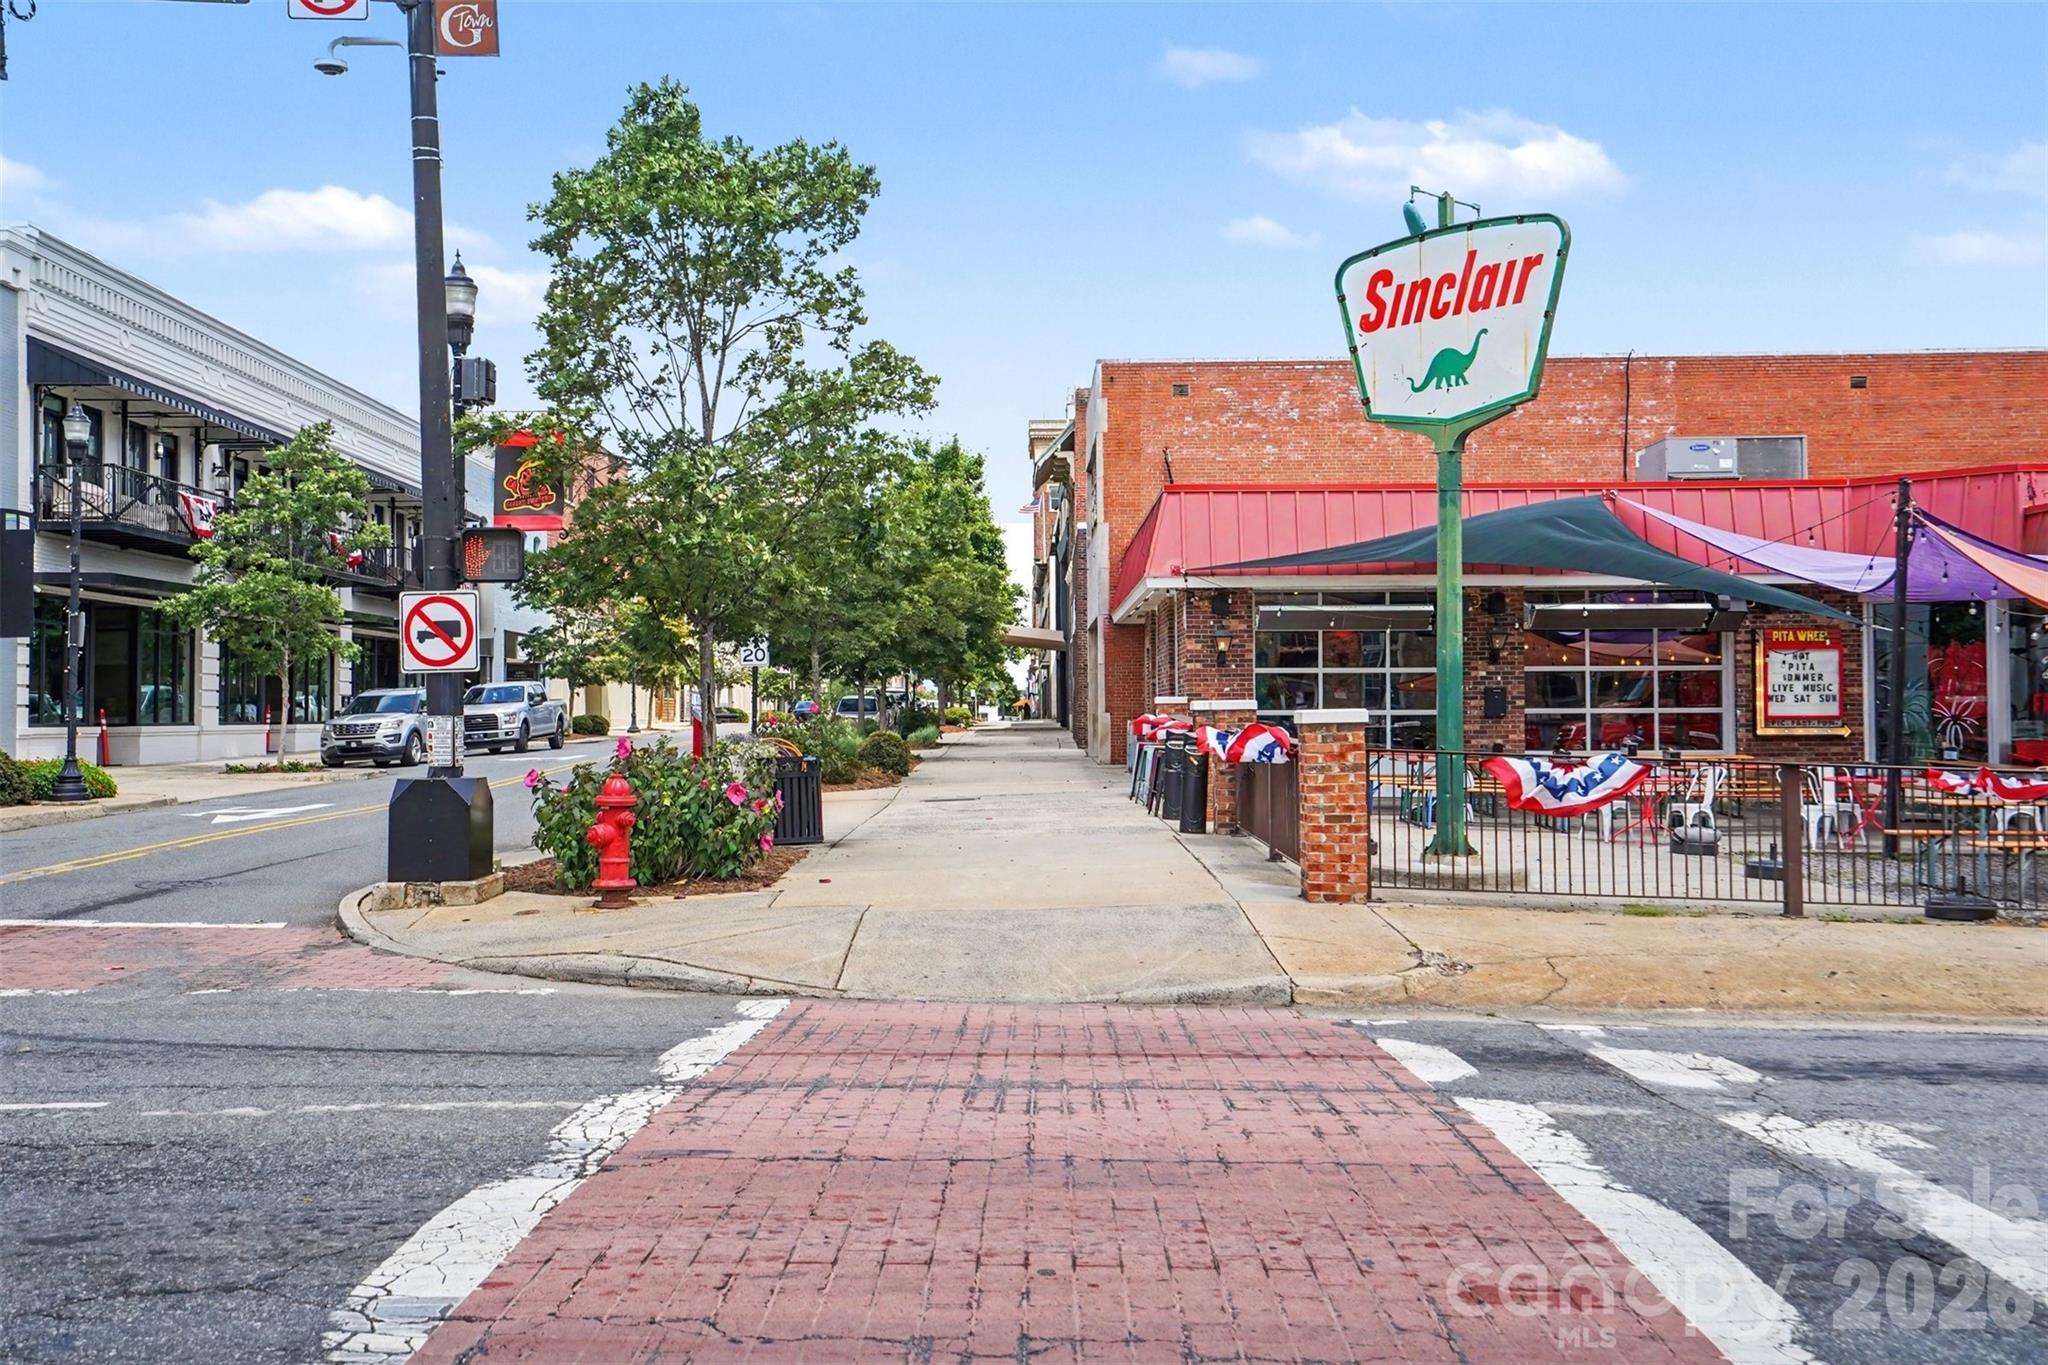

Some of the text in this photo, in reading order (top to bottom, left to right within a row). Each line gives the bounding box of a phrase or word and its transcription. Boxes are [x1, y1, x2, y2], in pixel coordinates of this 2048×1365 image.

[441, 4, 494, 47] G Town
[1359, 249, 1544, 333] Sinclair
[1772, 631, 1794, 641] PITA
[743, 648, 766, 662] 20
[1792, 652, 1810, 660] HOT
[1788, 663, 1815, 671] PITA
[1772, 683, 1833, 692] LIVE MUSIC
[1794, 694, 1811, 702] SAT
[1819, 694, 1837, 702] SUN
